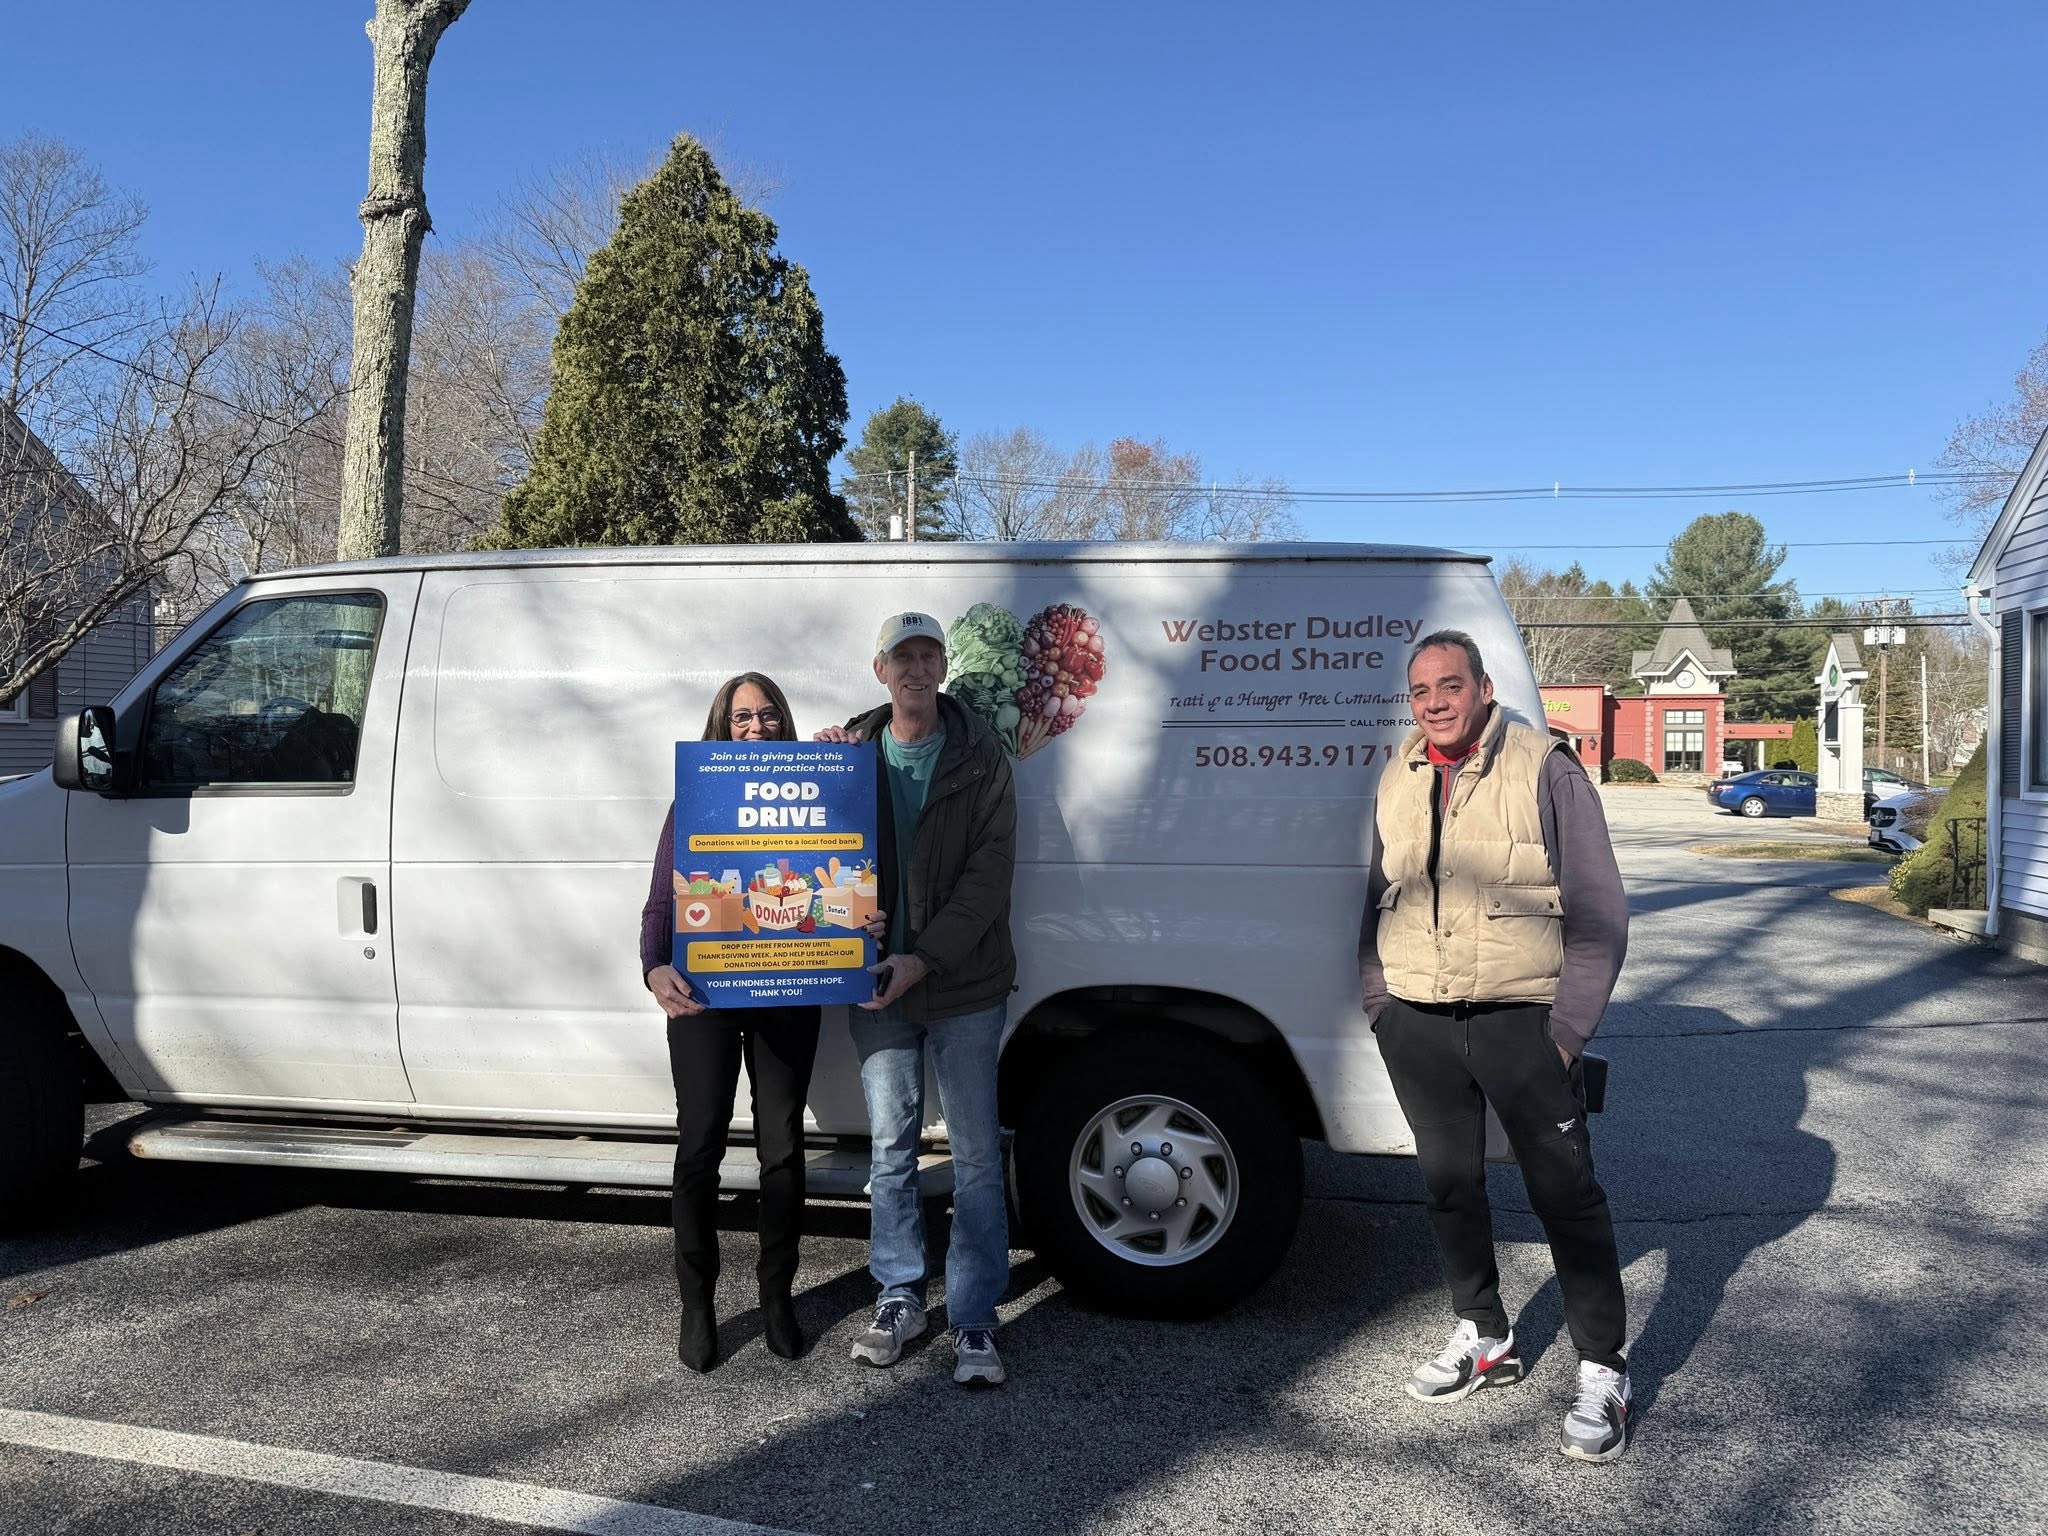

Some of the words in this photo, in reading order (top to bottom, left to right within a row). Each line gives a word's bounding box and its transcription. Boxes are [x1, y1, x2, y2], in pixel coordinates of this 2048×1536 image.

[1162, 618, 1296, 643] Webster
[1306, 615, 1424, 644] Dudley
[1200, 648, 1281, 672] Food
[1291, 647, 1384, 671] Share
[1224, 695, 1234, 707] a
[1237, 691, 1293, 712] Hunger
[1398, 718, 1418, 726] FOO
[710, 752, 733, 761] Join
[749, 752, 760, 760] in
[762, 752, 794, 762] giving
[796, 752, 822, 760] back
[824, 752, 843, 760] this
[1195, 744, 1393, 768] 508.943.9171
[772, 764, 816, 774] practice
[817, 764, 845, 772] hosts
[744, 781, 820, 801] FOOD
[738, 806, 827, 828] DRIVE
[751, 838, 761, 846] be
[762, 839, 784, 848] given
[756, 904, 804, 924] DONATE
[828, 906, 846, 915] Donate
[756, 942, 772, 950] HERE
[697, 952, 750, 960] THANKSGIVING
[762, 960, 782, 968] GOAL
[706, 980, 731, 988] YOUR
[732, 978, 775, 988] KINDNESS
[776, 978, 819, 986] RESTORES
[820, 976, 845, 985] HOPE.
[750, 989, 780, 998] THANK
[781, 988, 802, 996] YOU!
